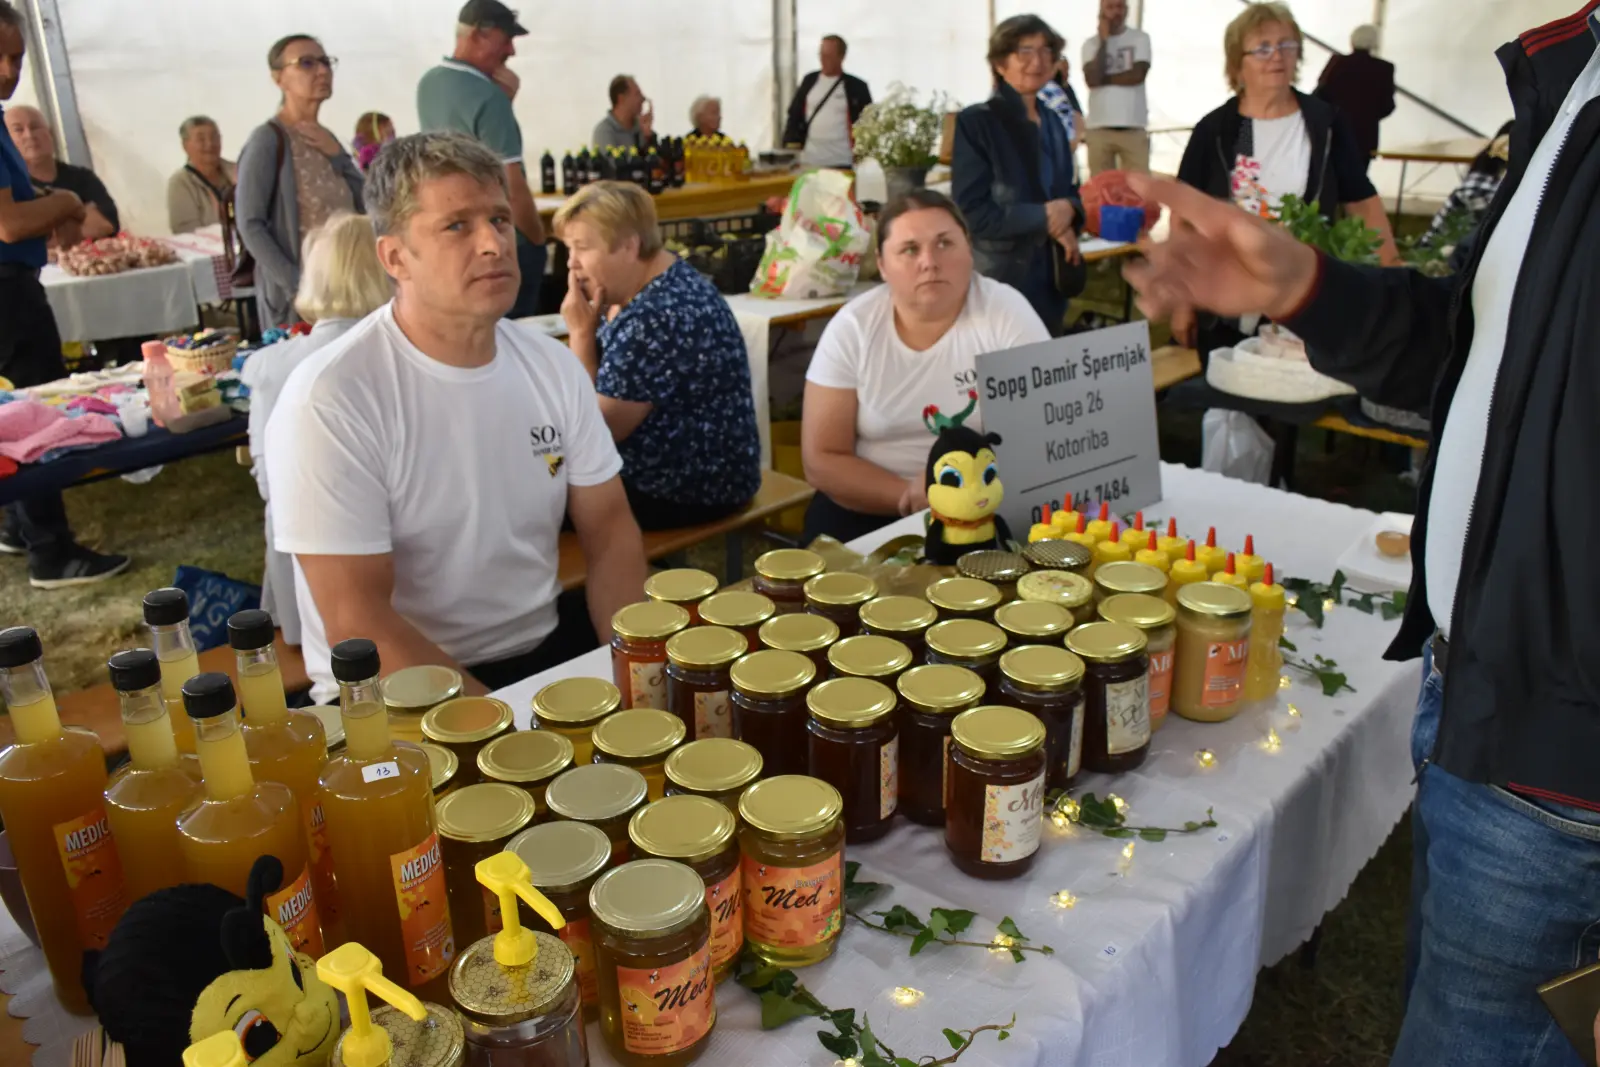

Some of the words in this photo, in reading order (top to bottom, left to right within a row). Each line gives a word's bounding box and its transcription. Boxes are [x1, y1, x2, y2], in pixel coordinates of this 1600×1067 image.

[954, 369, 978, 388] SO
[986, 374, 1028, 401] Sopg
[1031, 359, 1078, 389] Damir
[1081, 343, 1147, 380] Špernjak
[1043, 400, 1083, 426] Duga
[1086, 390, 1104, 414] 26
[530, 425, 561, 446] SO
[1045, 429, 1109, 464] Kotoriba
[376, 766, 391, 776] 13
[64, 818, 109, 852] MEDIC
[278, 879, 313, 924] MEDIC
[762, 885, 822, 909] Med
[654, 965, 710, 1012] Med
